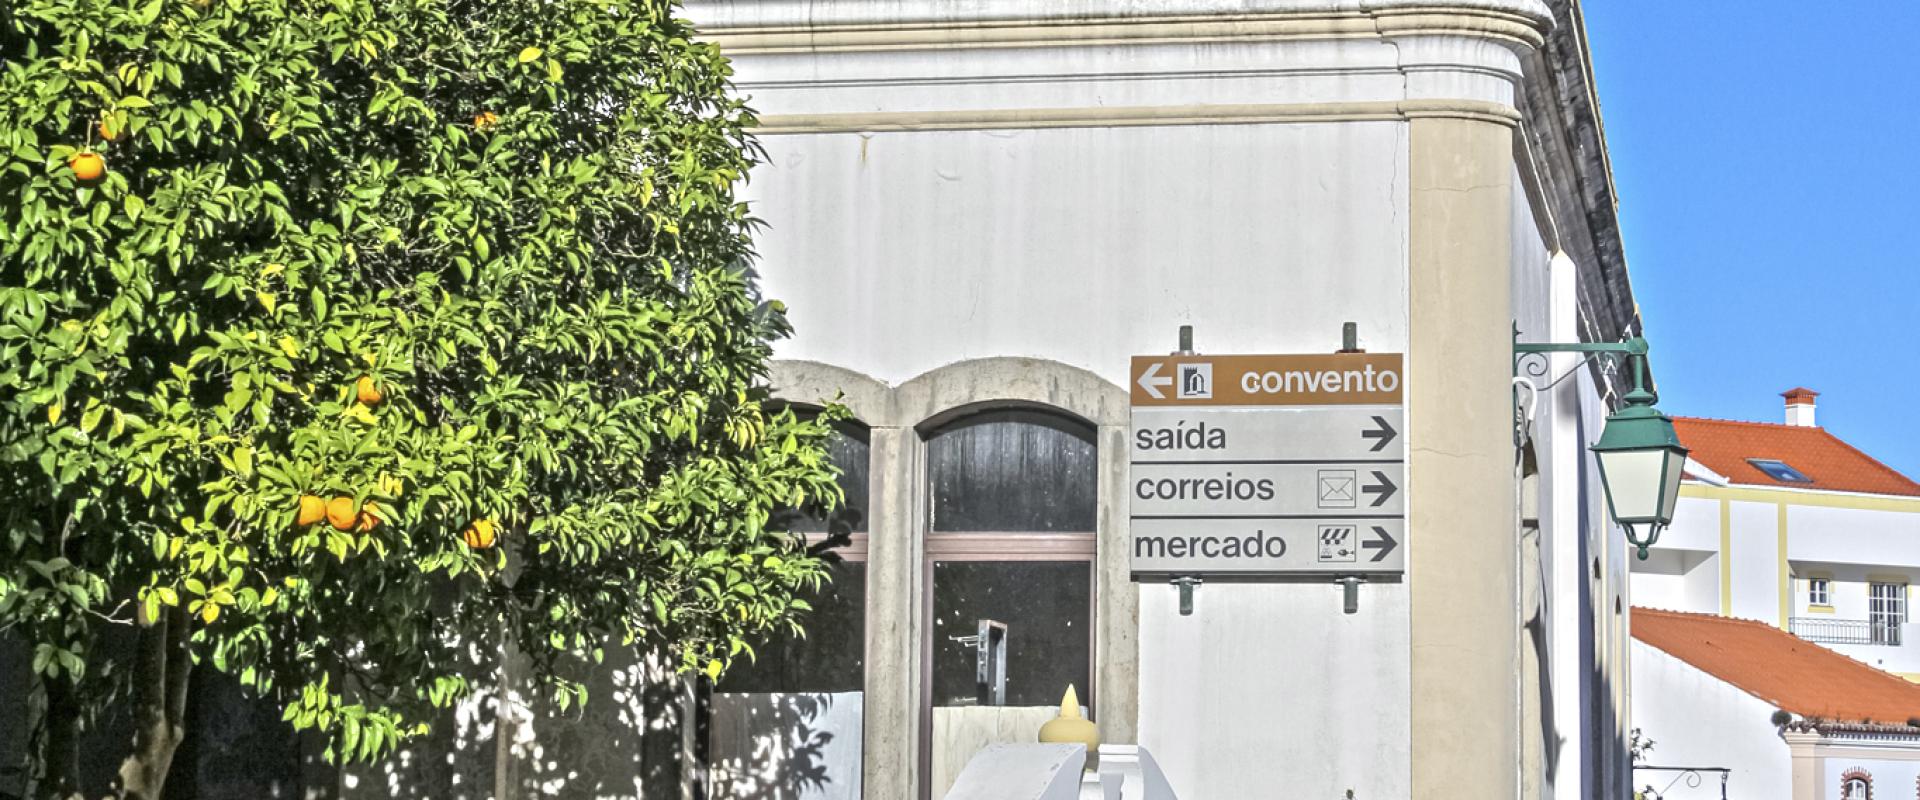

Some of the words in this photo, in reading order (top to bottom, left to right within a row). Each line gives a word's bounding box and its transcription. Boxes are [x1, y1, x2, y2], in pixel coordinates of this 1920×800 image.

[1241, 363, 1399, 394] convento
[1136, 420, 1226, 451] saída
[1136, 472, 1275, 501] correios
[1135, 530, 1287, 559] mercado
